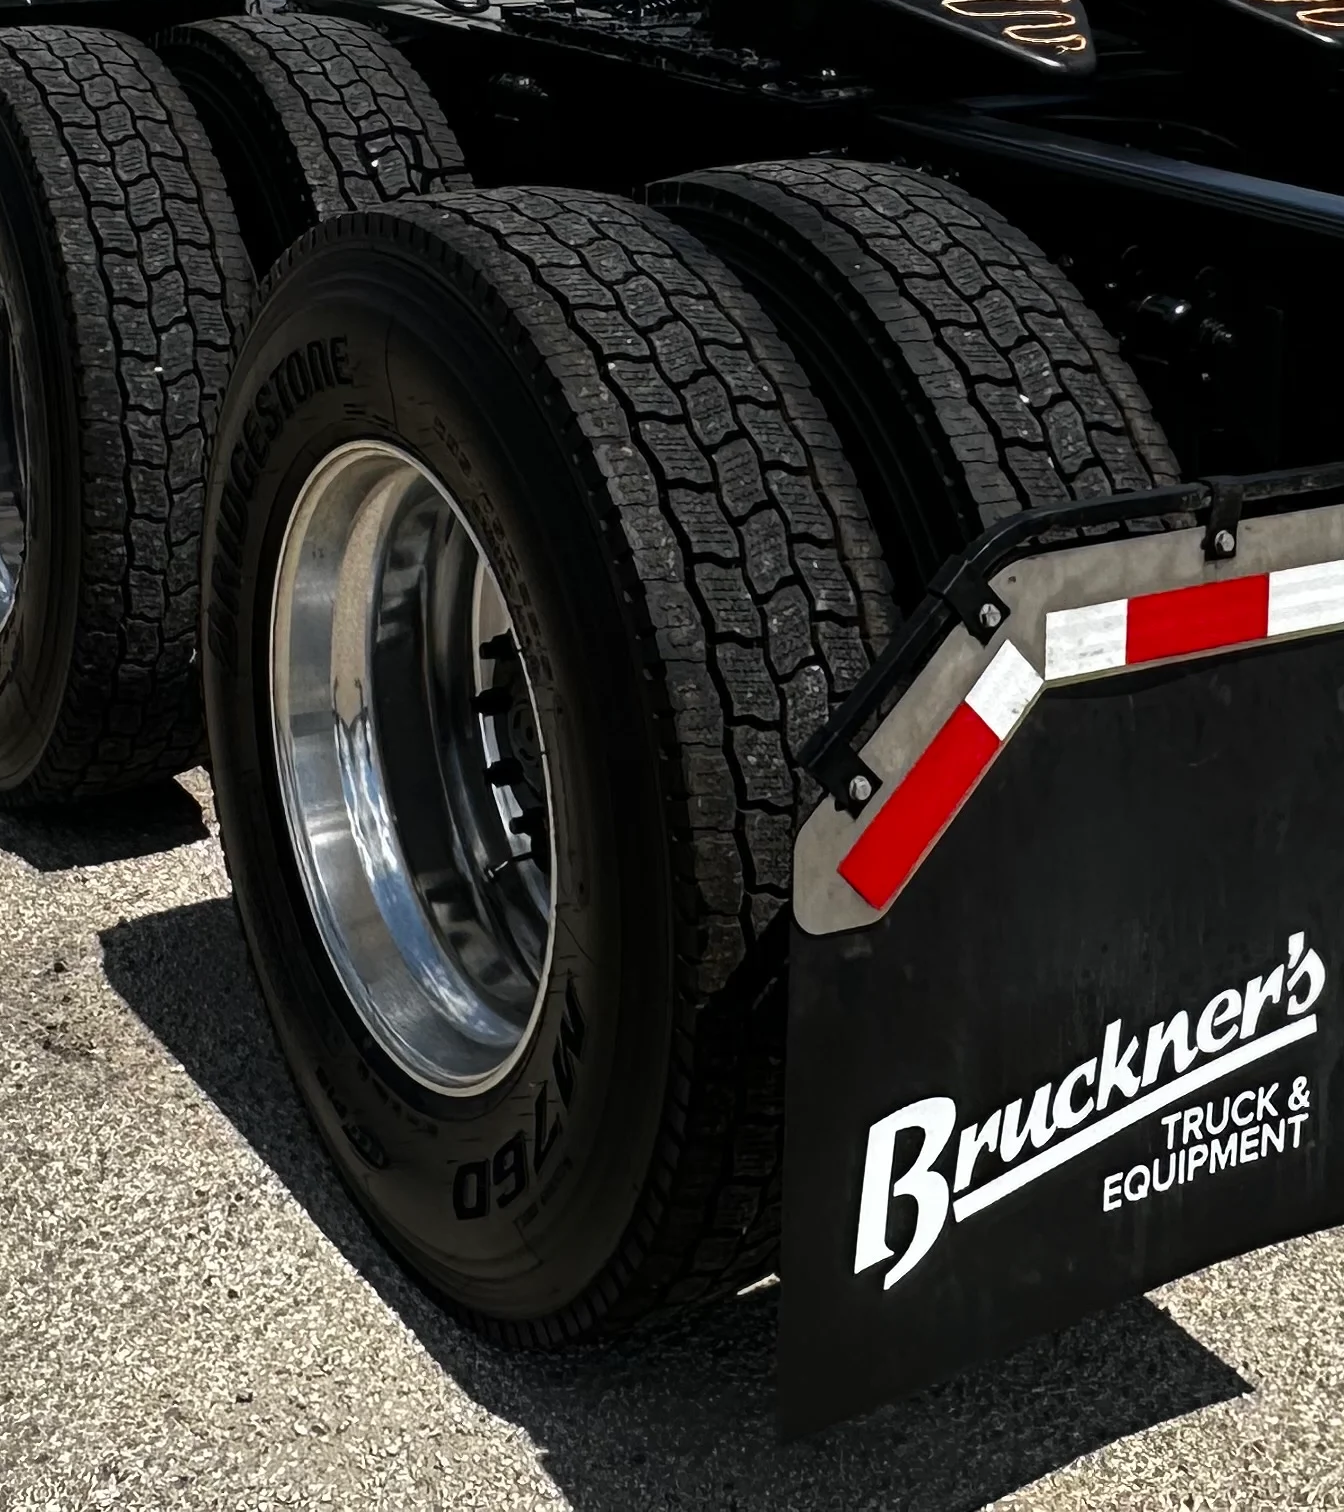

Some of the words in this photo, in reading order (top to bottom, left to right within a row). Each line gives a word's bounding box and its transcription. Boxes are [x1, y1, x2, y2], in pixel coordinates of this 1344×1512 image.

[853, 930, 1327, 1291] Bruckner's
[1160, 1081, 1280, 1151] TRUCK
[1288, 1075, 1312, 1113] &
[1102, 1112, 1311, 1213] EQUIPMENT
